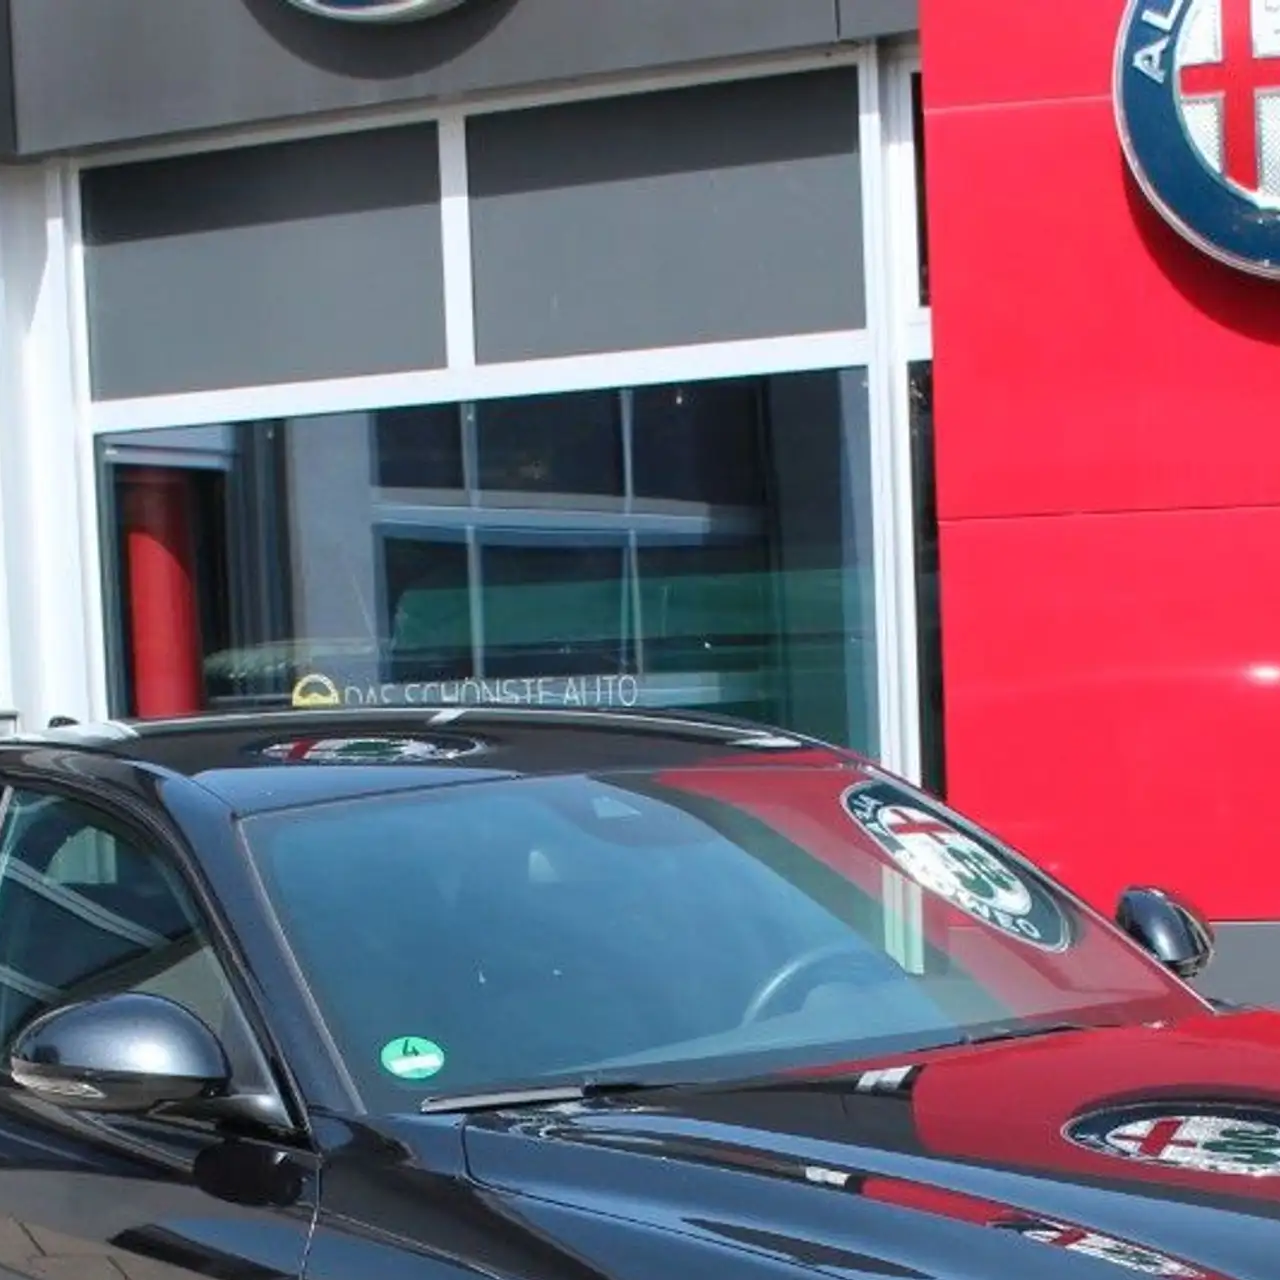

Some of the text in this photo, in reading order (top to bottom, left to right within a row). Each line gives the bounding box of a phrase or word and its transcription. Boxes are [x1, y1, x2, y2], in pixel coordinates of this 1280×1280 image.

[1133, 0, 1184, 84] AL
[343, 682, 396, 705] DAS
[562, 674, 638, 706] AUTO
[402, 1039, 420, 1056] 4
